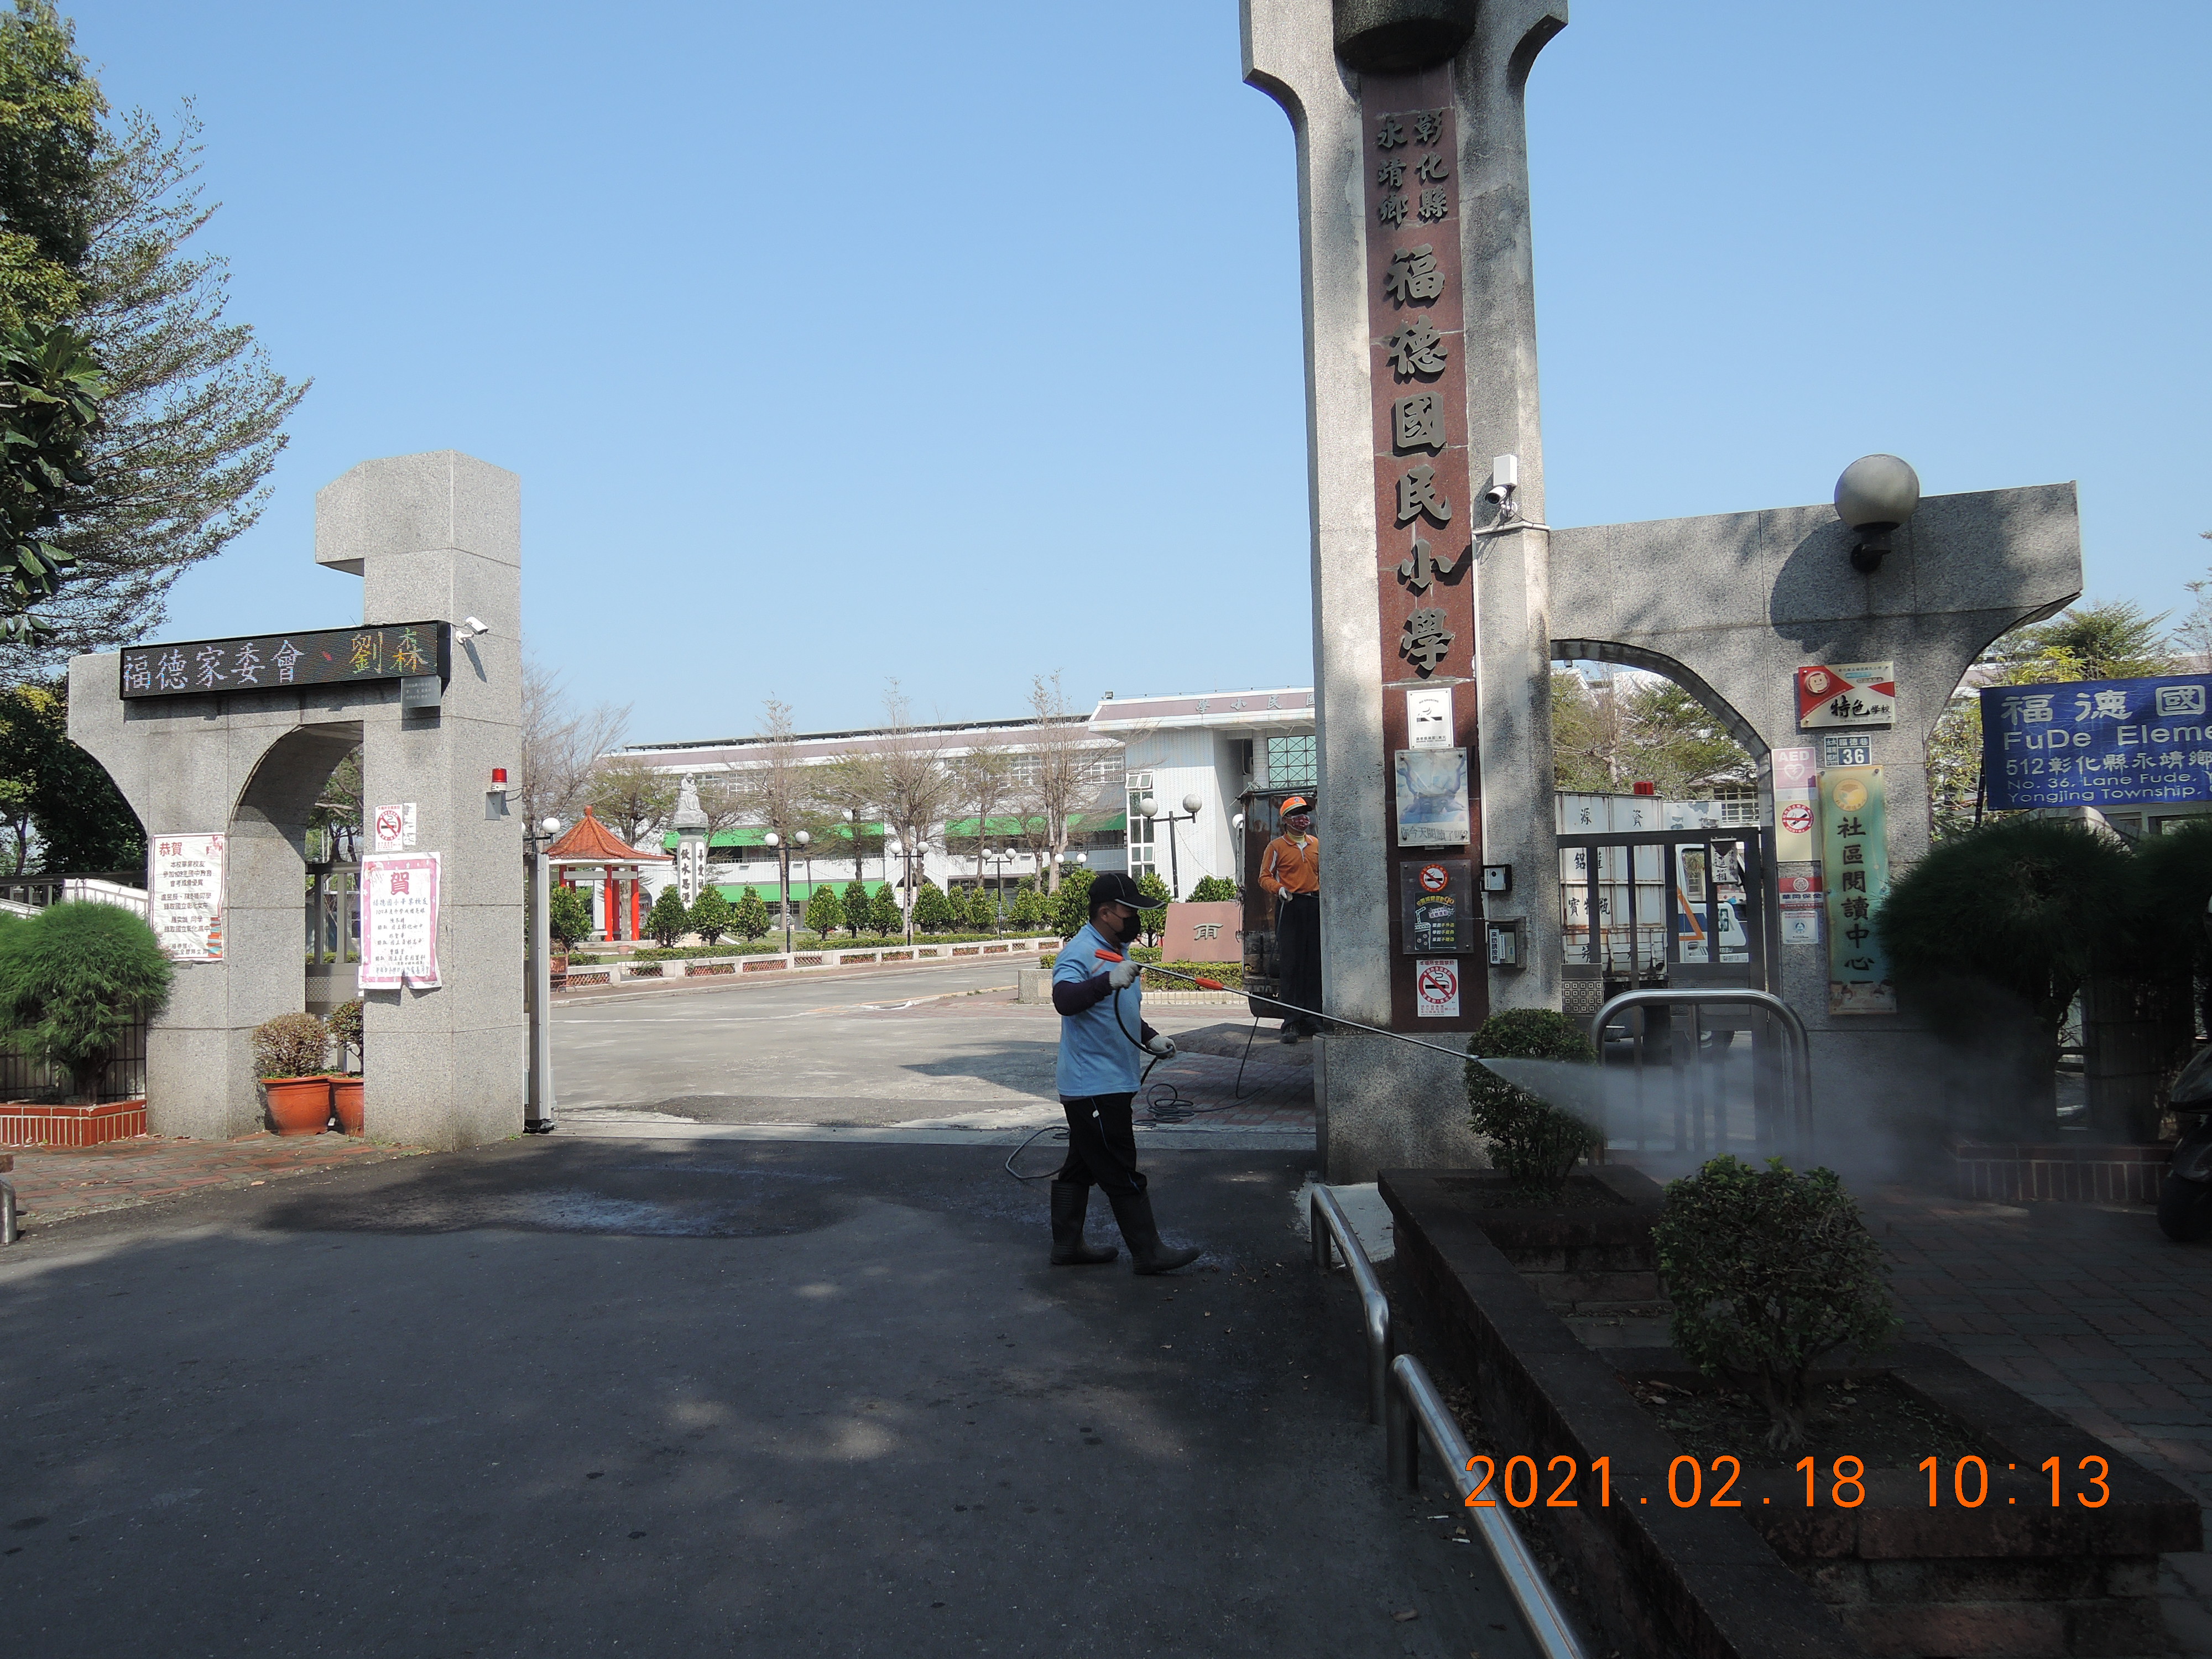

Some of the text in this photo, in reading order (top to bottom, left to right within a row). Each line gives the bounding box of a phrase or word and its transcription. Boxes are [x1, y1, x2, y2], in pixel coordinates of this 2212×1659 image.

[1377, 118, 1408, 222] 永靖鄉
[1415, 111, 1449, 221] 彰化縣
[1387, 242, 1455, 672] 福德國民小學
[2000, 685, 2206, 726] 福德國
[1839, 738, 1868, 746] 福德巷
[2004, 729, 2092, 750] FuDe
[1778, 750, 1810, 762] AED
[1843, 748, 1865, 764] 36
[2007, 780, 2041, 790] No.
[2083, 774, 2133, 787] Lane
[2007, 790, 2095, 804] Yongjing
[159, 842, 182, 857] 恭賀
[390, 872, 409, 895] 賀
[1837, 816, 1875, 971] 社區閱讀中心
[1193, 923, 1224, 941] 雨
